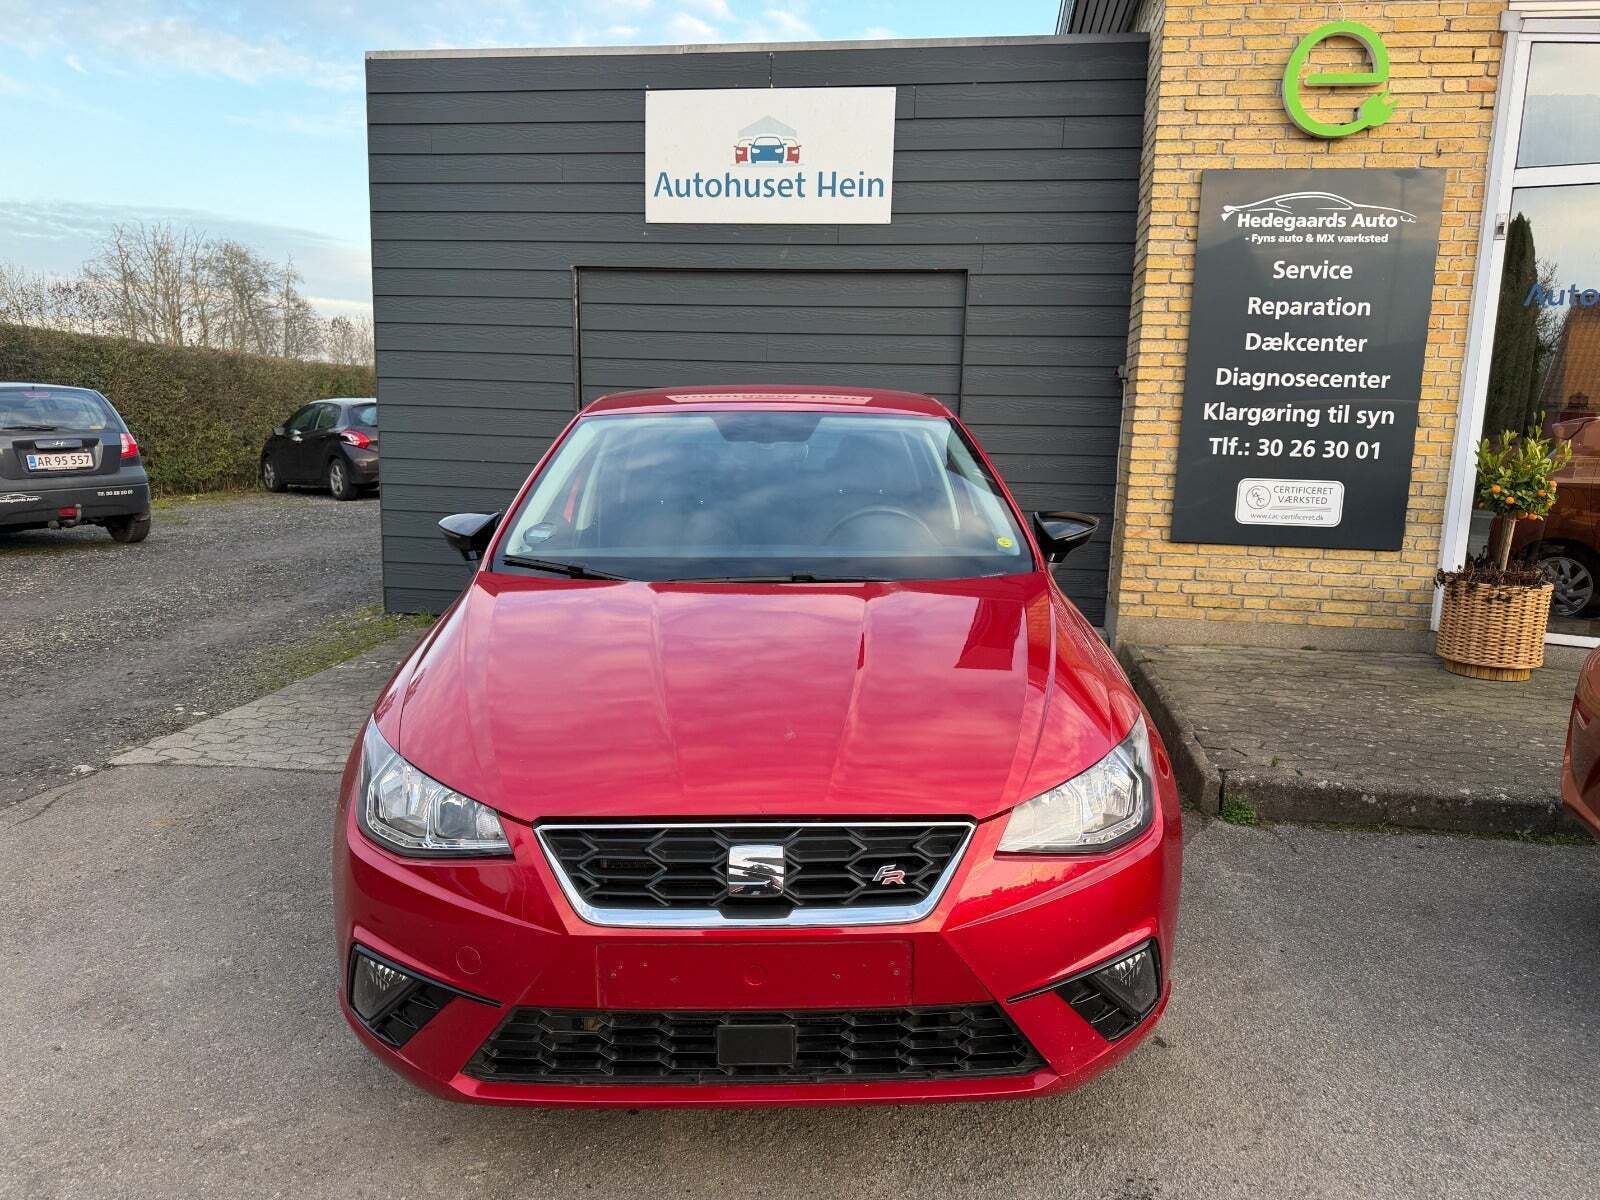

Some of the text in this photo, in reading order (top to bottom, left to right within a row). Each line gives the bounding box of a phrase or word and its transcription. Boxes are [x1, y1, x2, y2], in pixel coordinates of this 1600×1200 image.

[654, 171, 884, 198] Autohuset Hein
[1237, 212, 1398, 232] Hedegaards Auto
[1251, 234, 1276, 244] Fyns
[1278, 234, 1303, 243] auto
[1305, 234, 1313, 243] &
[1316, 234, 1335, 243] MX
[1337, 233, 1389, 243] værksted
[1273, 260, 1353, 279] Service
[1247, 296, 1371, 320] Reparation
[1245, 331, 1368, 352] Dækcenter
[1215, 367, 1391, 391] Diagnosecenter
[1203, 402, 1395, 429] Klargøring til syn
[1208, 437, 1381, 460] Tlf.: 30 26 30 01
[38, 455, 90, 466] AR 95 557
[1273, 485, 1334, 495] CERTIFICERET
[1277, 495, 1328, 505] VÆRKSTED
[872, 863, 905, 885] FR
